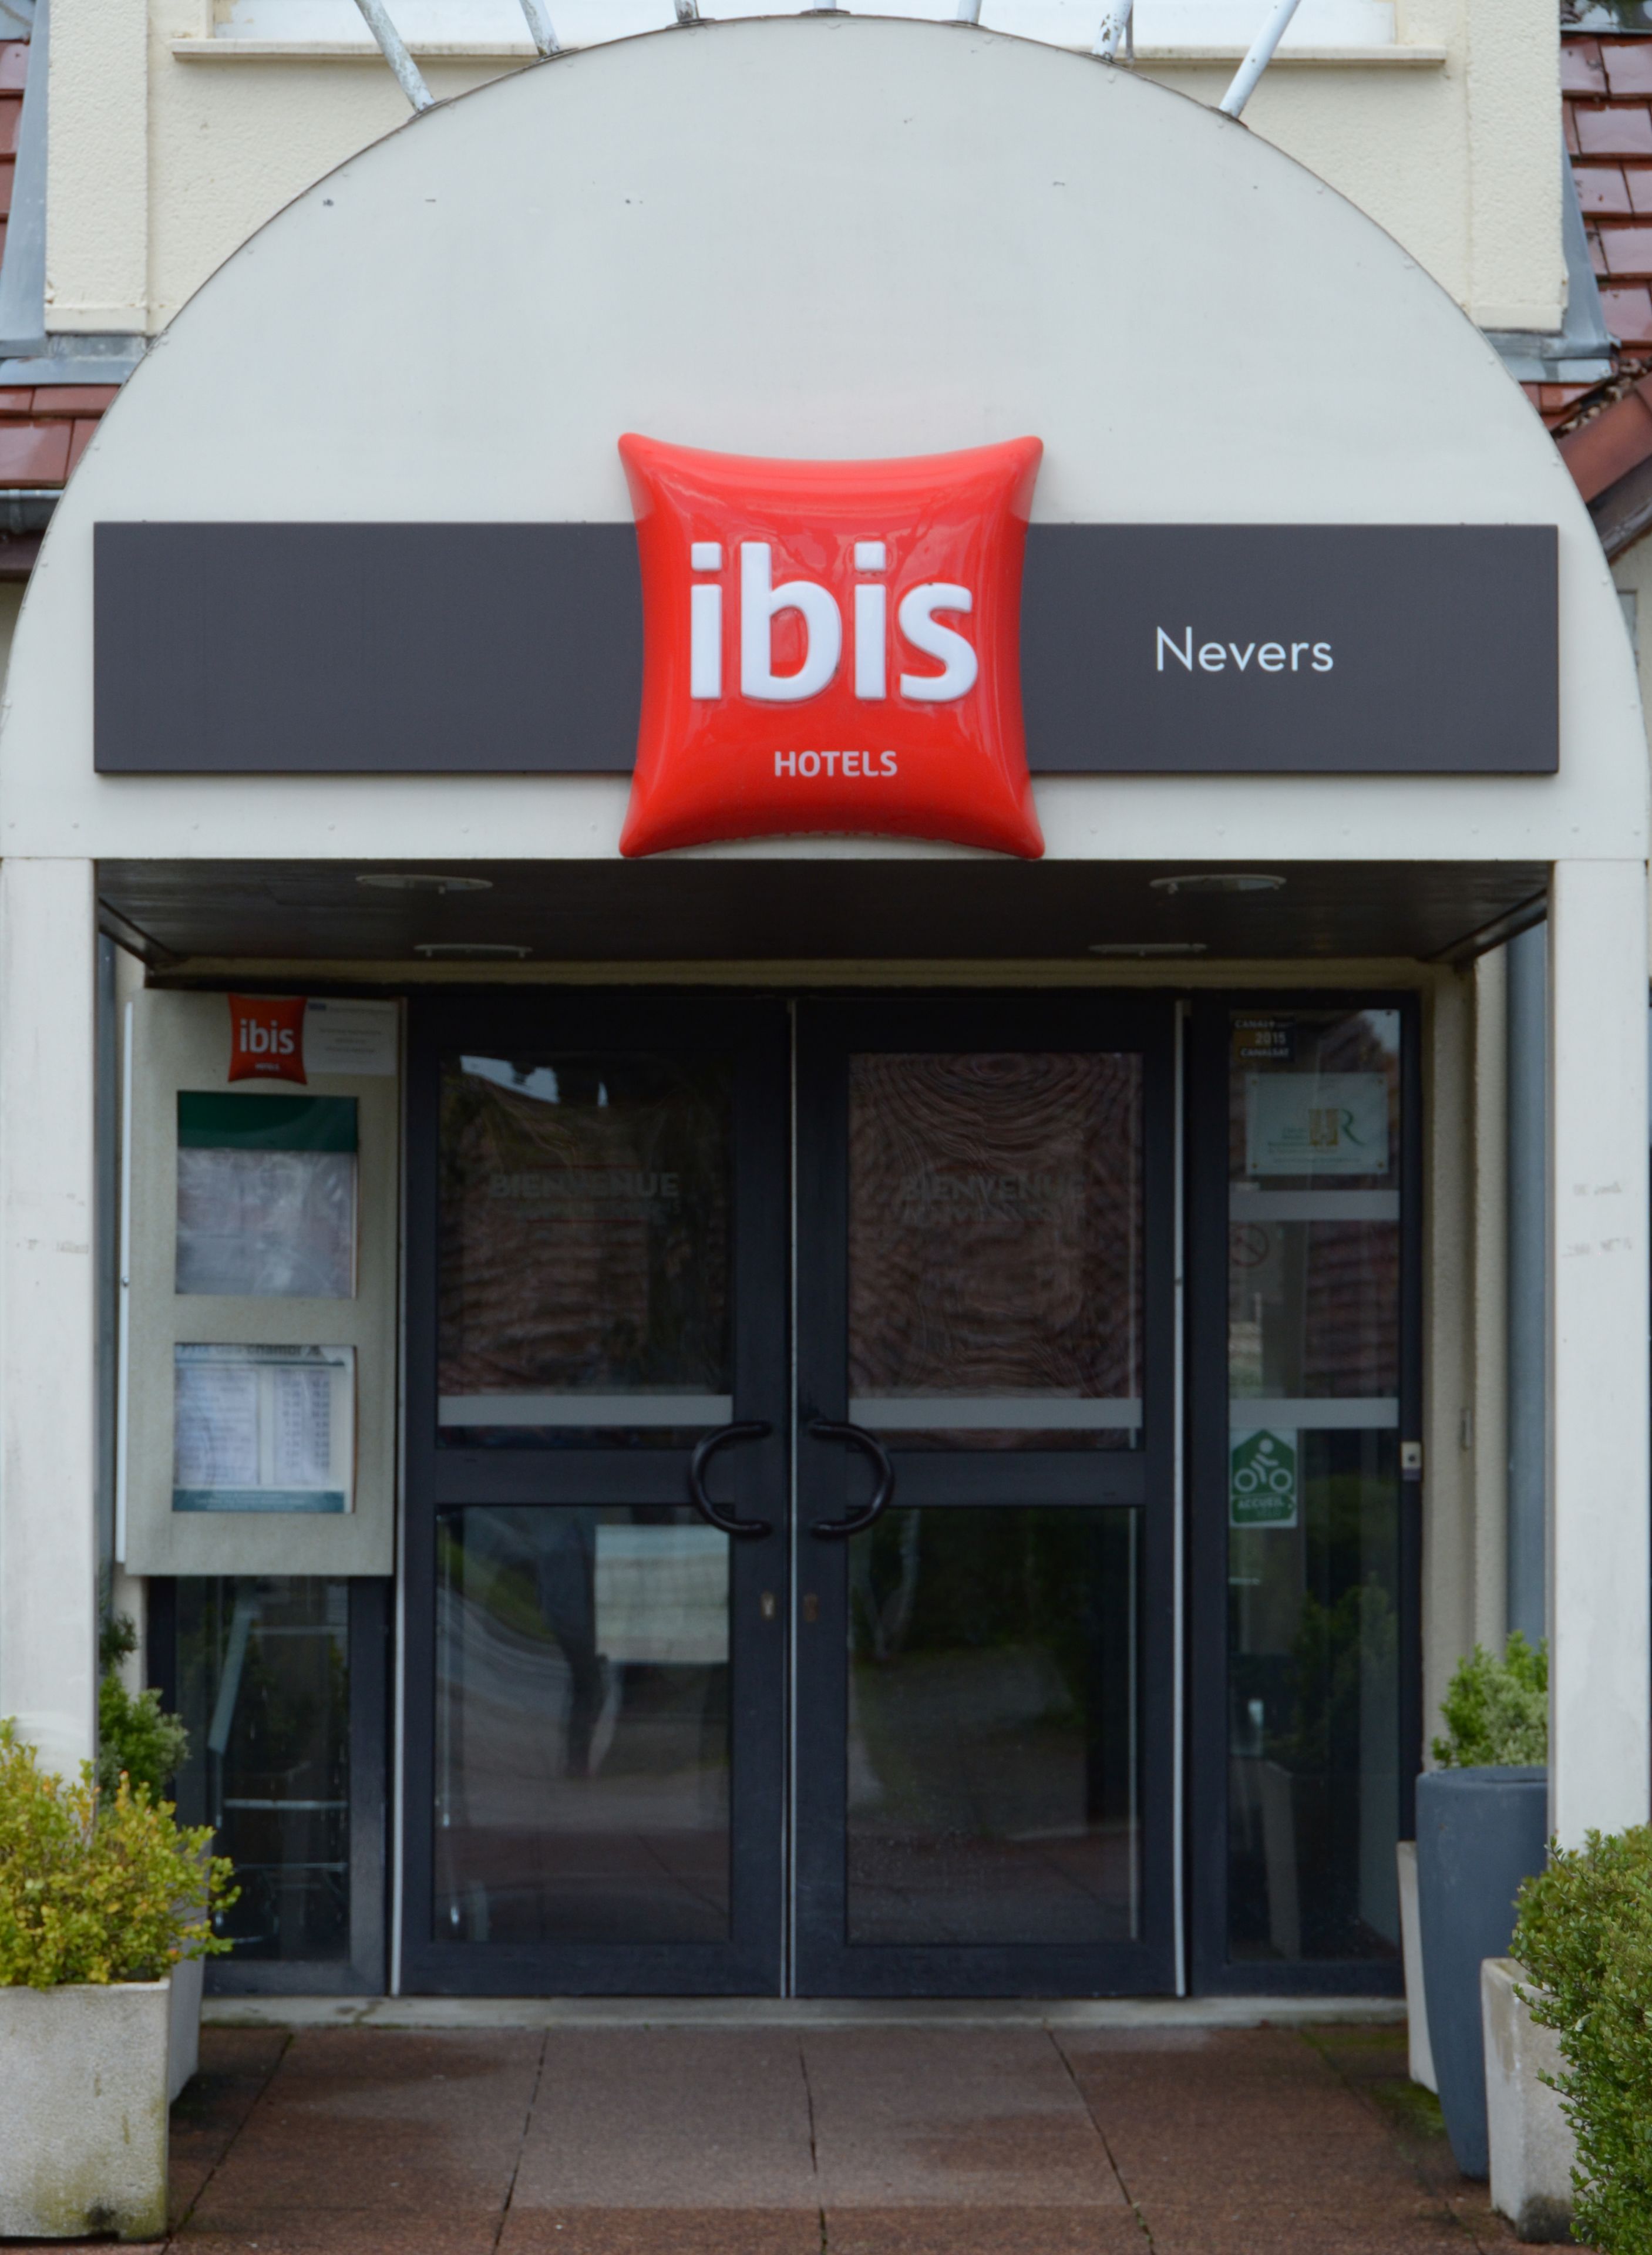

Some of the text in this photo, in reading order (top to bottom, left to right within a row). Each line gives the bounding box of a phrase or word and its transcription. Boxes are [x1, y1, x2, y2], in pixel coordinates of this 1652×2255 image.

[690, 540, 979, 703] ibis
[1156, 625, 1335, 672] Nevers
[774, 749, 898, 778] HOTELS
[240, 1018, 295, 1055] ibis
[1255, 1031, 1286, 1045] 2015
